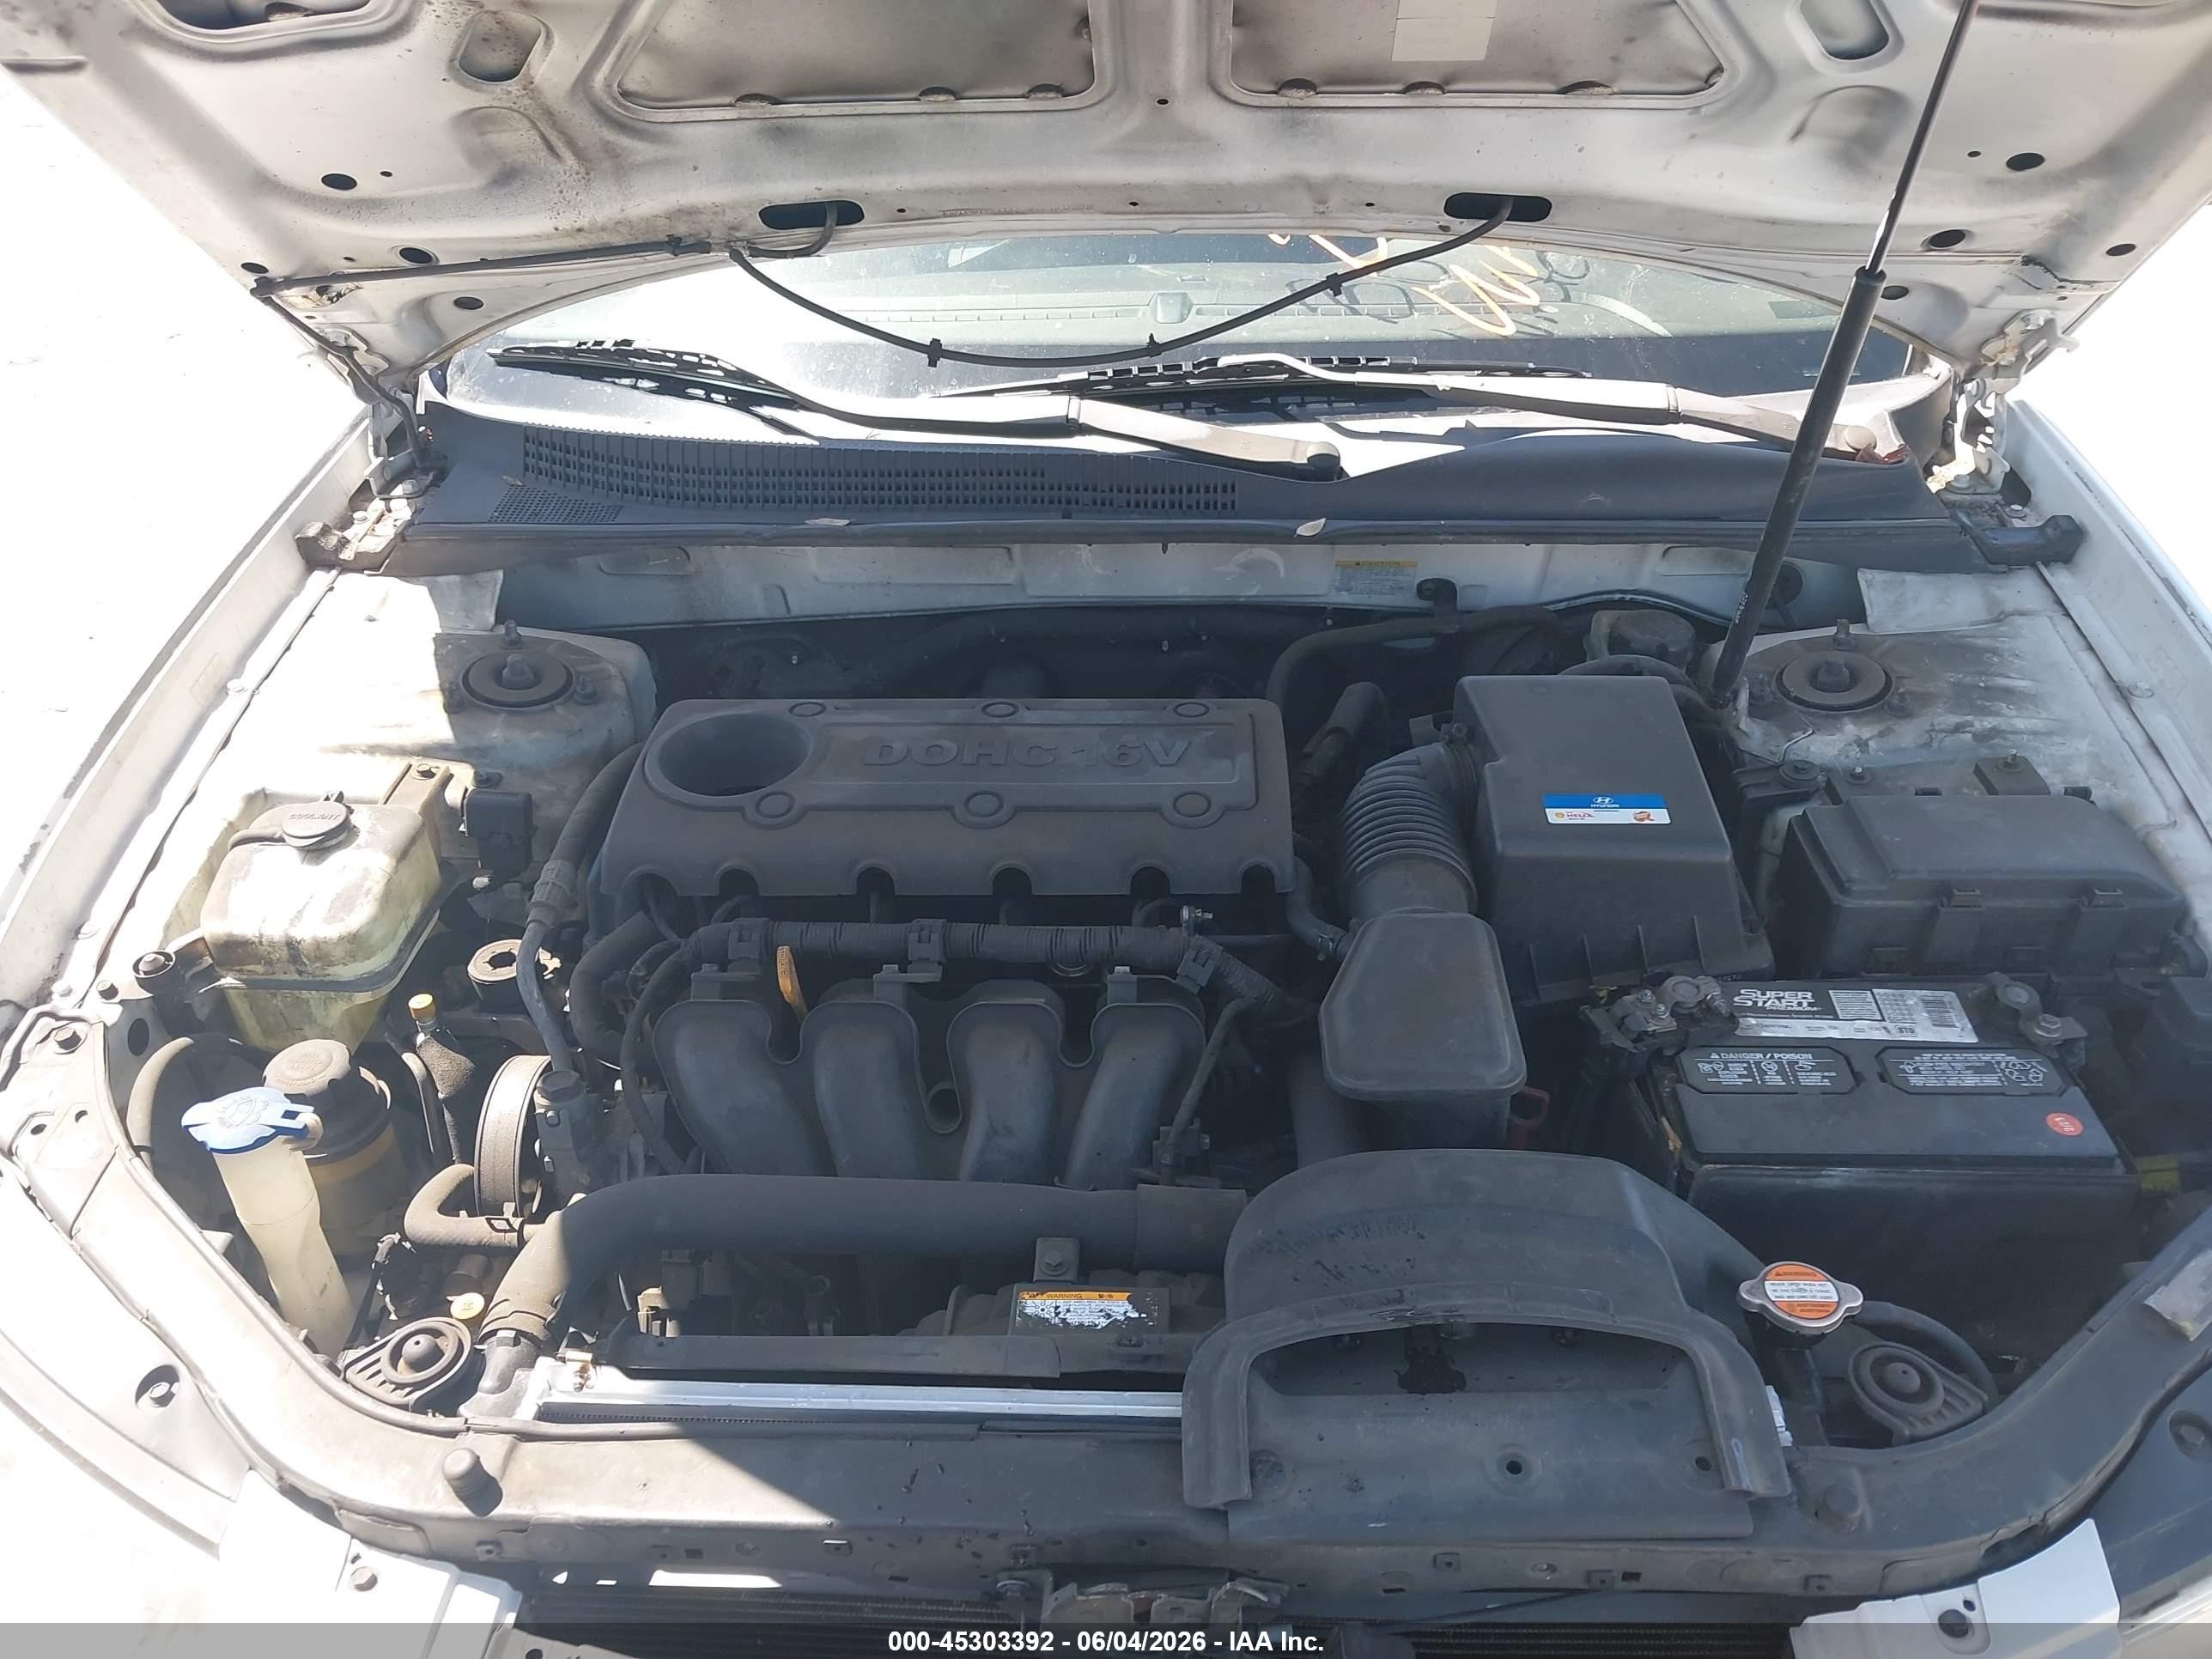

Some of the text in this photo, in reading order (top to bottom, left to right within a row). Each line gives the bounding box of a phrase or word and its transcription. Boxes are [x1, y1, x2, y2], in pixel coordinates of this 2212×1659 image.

[863, 740, 1193, 767] DOHC 16V
[289, 812, 342, 821] COOLANT
[1739, 988, 1814, 1000] SUPER
[1733, 997, 1815, 1007] START
